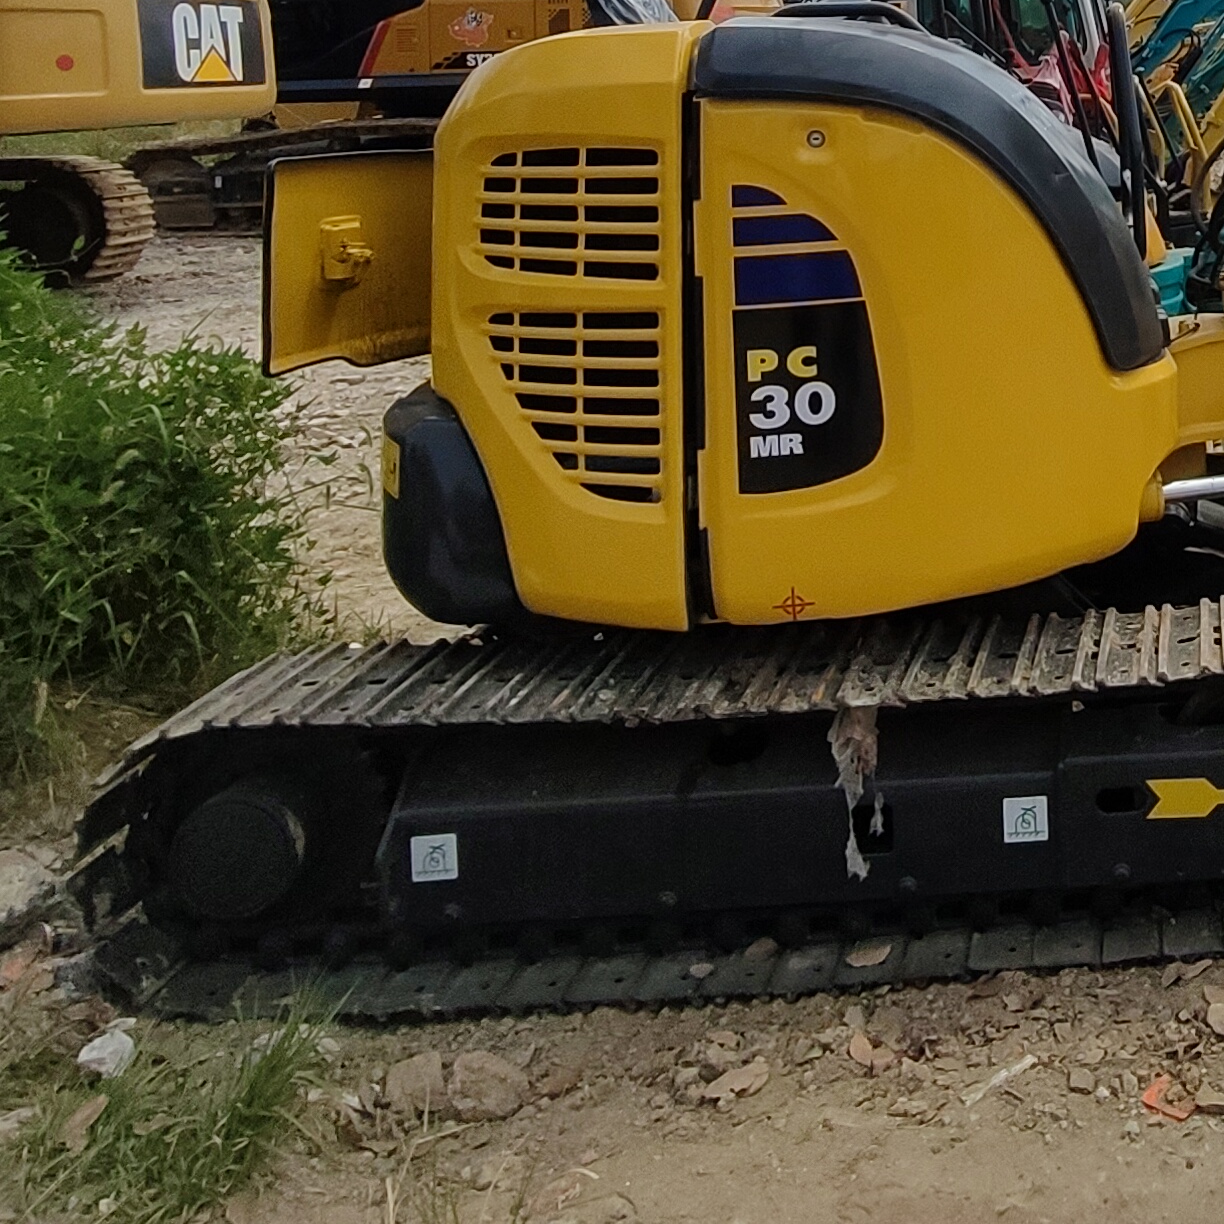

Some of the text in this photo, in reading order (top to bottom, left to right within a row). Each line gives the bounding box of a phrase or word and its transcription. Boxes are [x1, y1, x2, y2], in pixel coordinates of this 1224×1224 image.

[172, 2, 244, 83] CAT
[746, 345, 818, 382] PC
[749, 380, 836, 429] 30
[749, 433, 804, 458] MR
